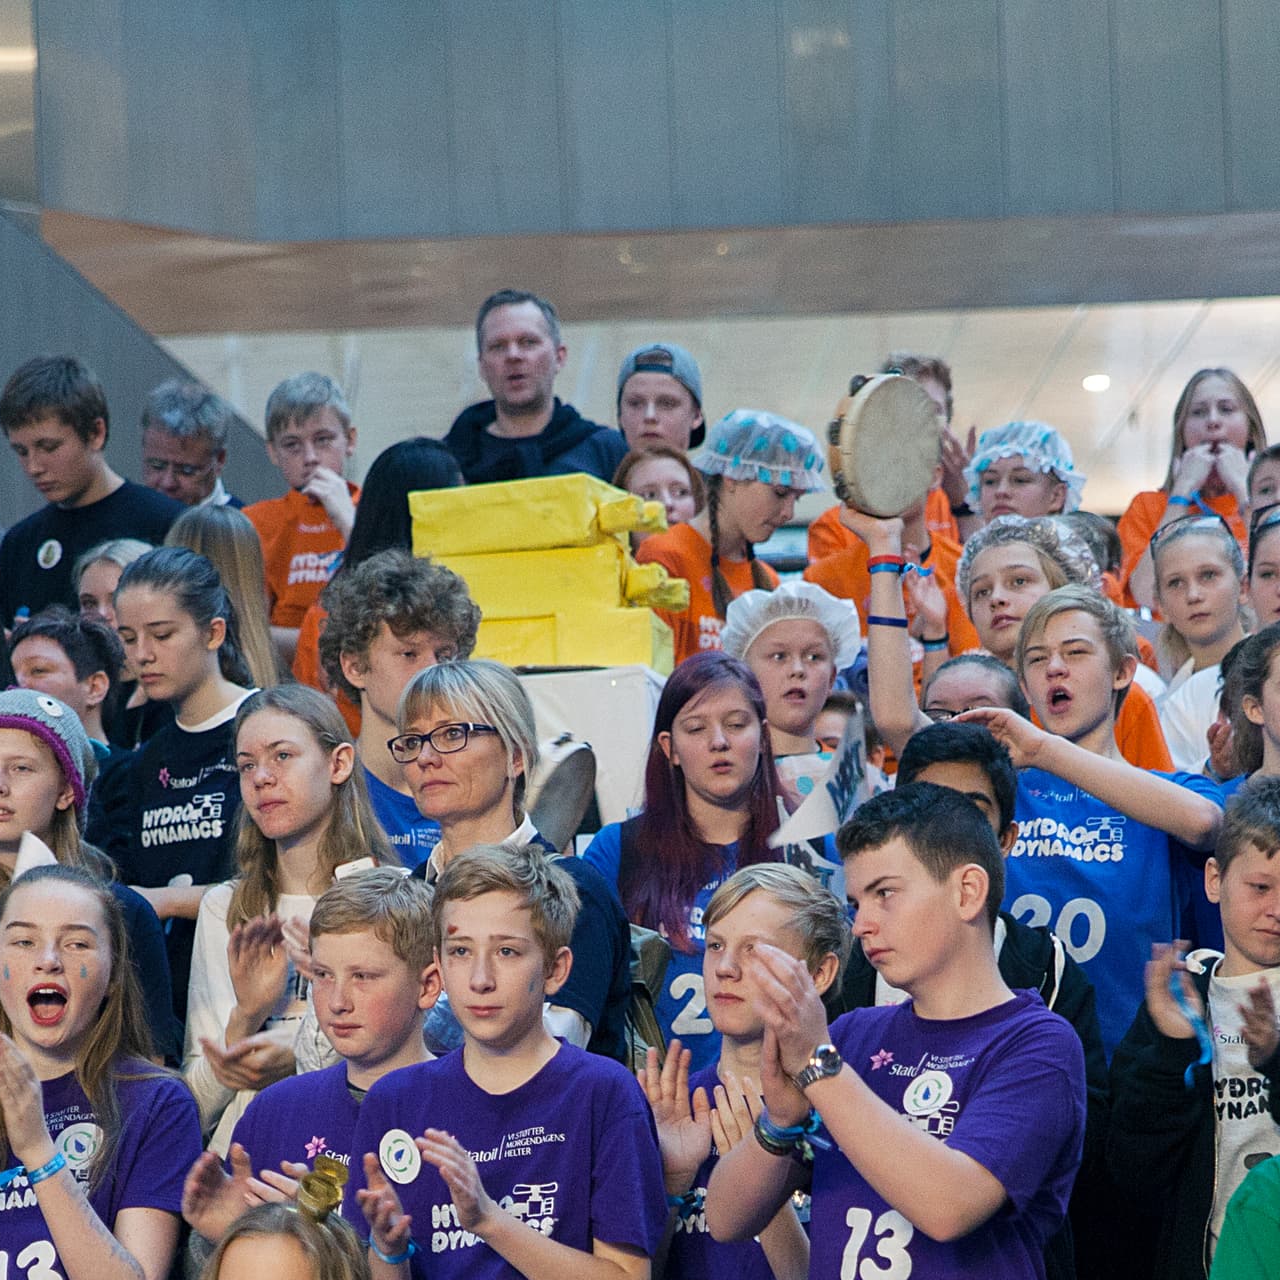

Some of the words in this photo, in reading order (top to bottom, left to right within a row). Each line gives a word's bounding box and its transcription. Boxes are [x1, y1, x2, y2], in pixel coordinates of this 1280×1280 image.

[142, 802, 195, 829] HYDRO
[141, 819, 223, 848] DYNAMICS
[1011, 838, 1125, 863] DYNAMICS
[1215, 1095, 1272, 1121] YNAM
[504, 1147, 532, 1158] HELTER
